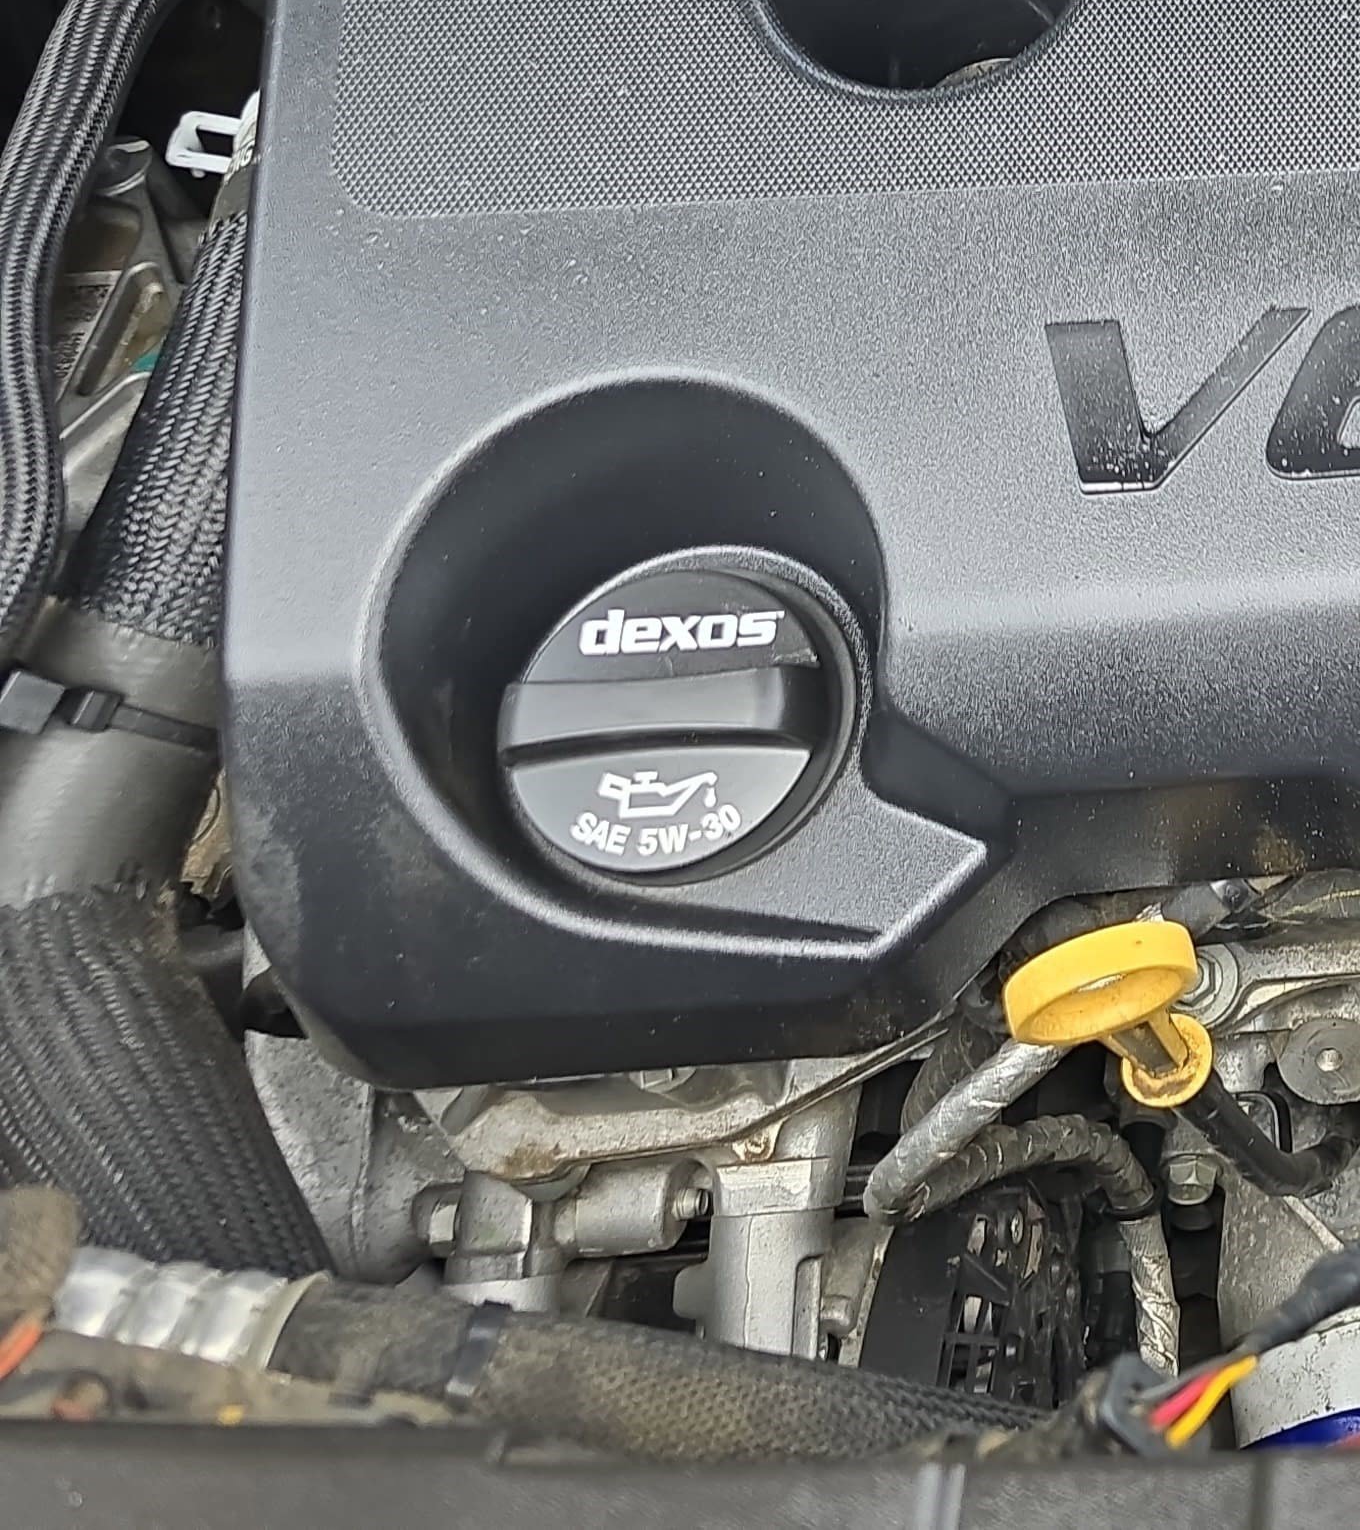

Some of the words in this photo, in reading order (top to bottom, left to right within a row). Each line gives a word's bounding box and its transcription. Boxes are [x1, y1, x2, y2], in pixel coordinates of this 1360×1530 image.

[579, 608, 780, 657] dexos
[569, 810, 631, 858] SAE
[635, 802, 742, 858] 5W-30
